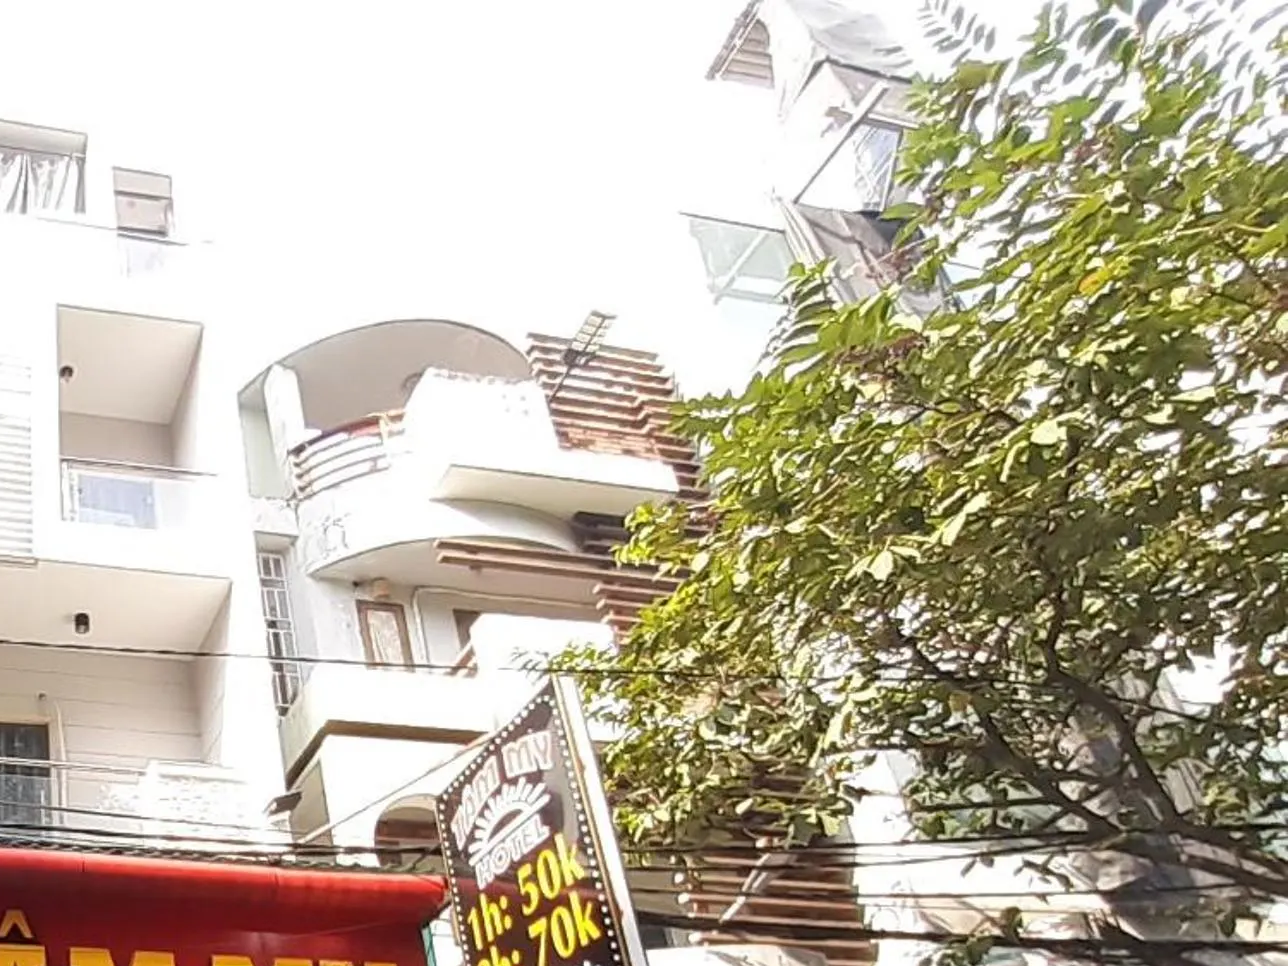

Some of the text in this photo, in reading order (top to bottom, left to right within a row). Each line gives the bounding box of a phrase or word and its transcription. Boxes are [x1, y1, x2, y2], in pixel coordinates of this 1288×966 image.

[467, 833, 584, 951] 1h: 50k
[475, 813, 551, 891] HOTEL
